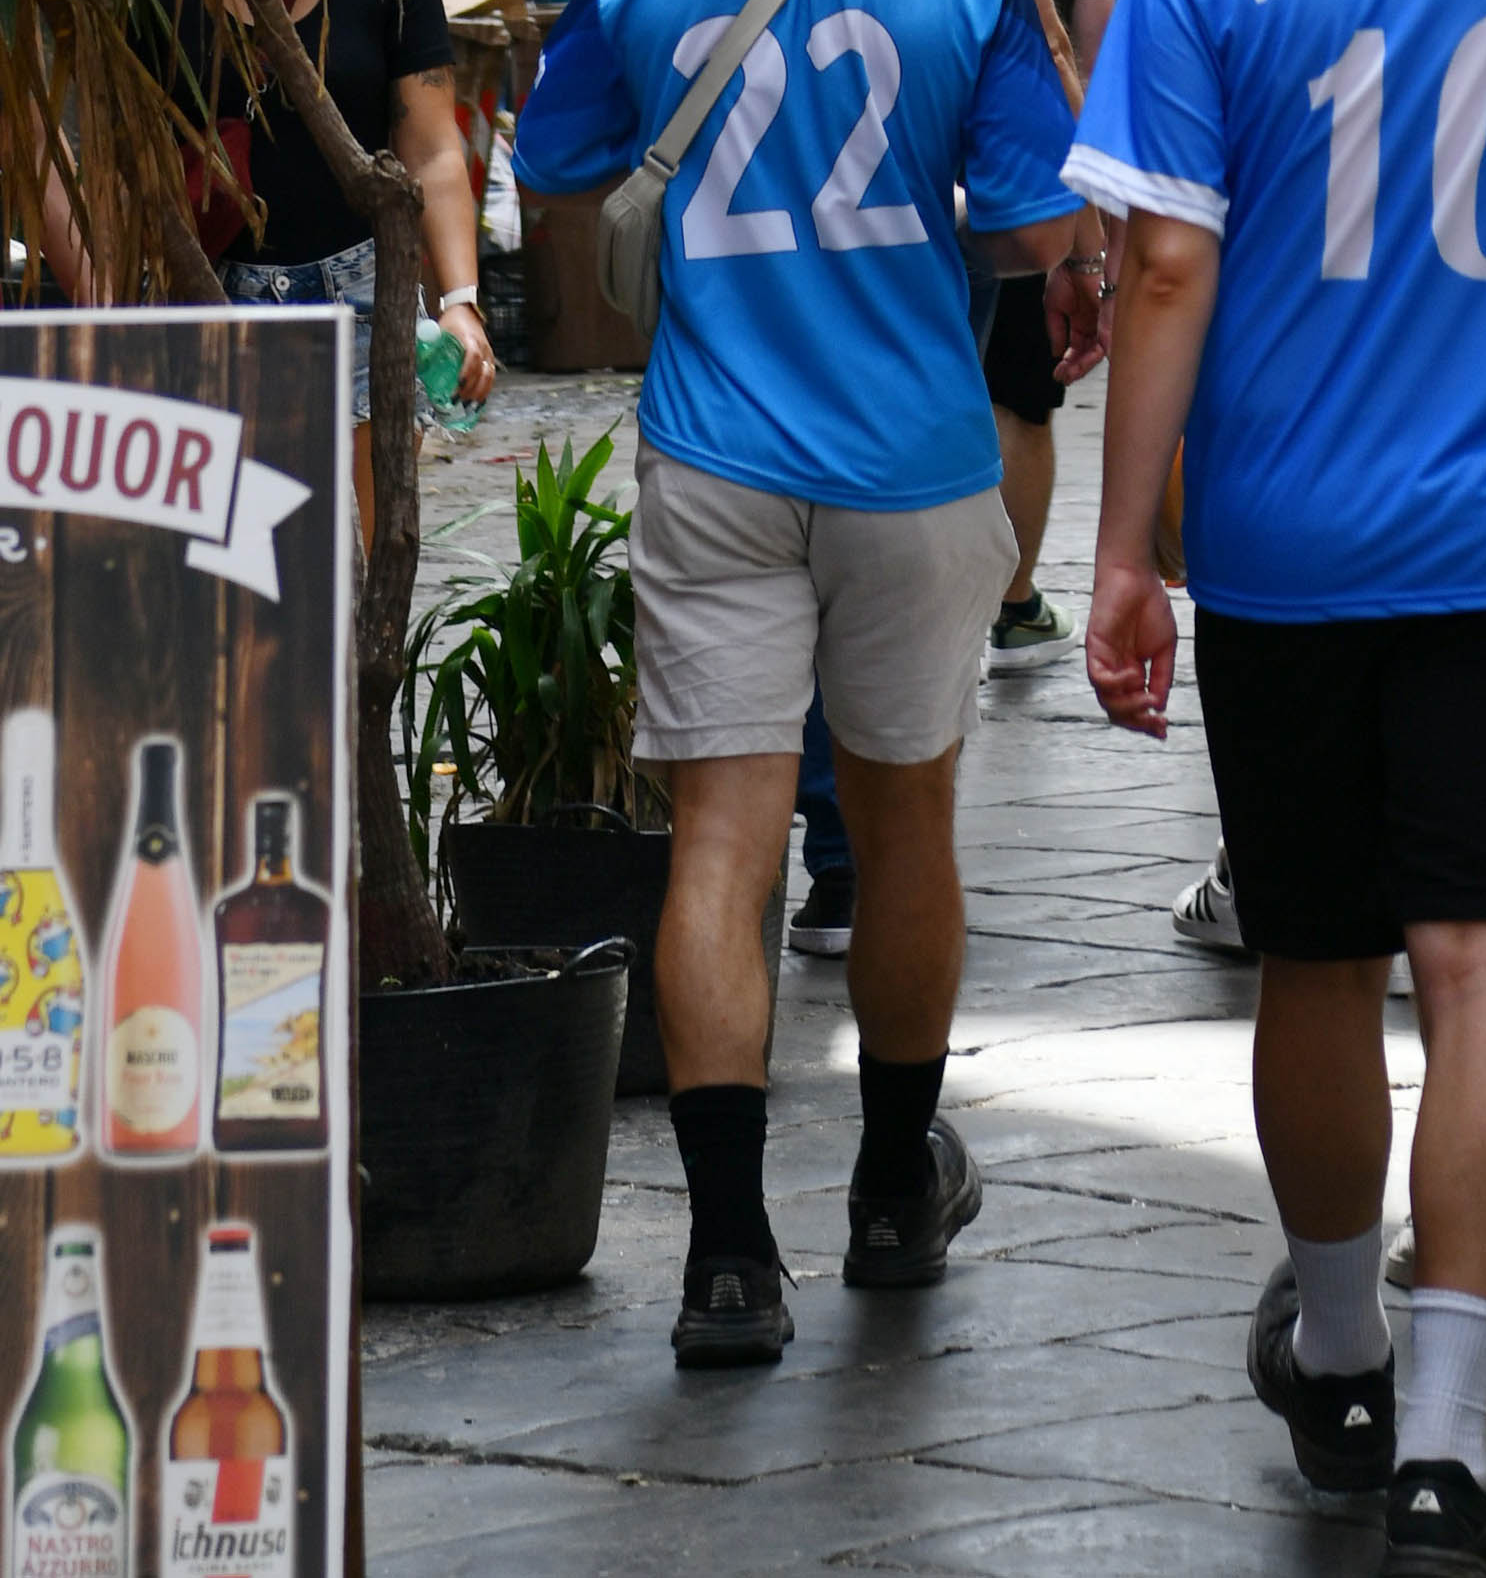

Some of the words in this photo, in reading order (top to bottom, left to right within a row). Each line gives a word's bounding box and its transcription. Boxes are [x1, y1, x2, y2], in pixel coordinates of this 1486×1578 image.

[673, 8, 930, 261] 22
[28, 1534, 110, 1556] NASTRO
[22, 1556, 118, 1578] AZZURRO
